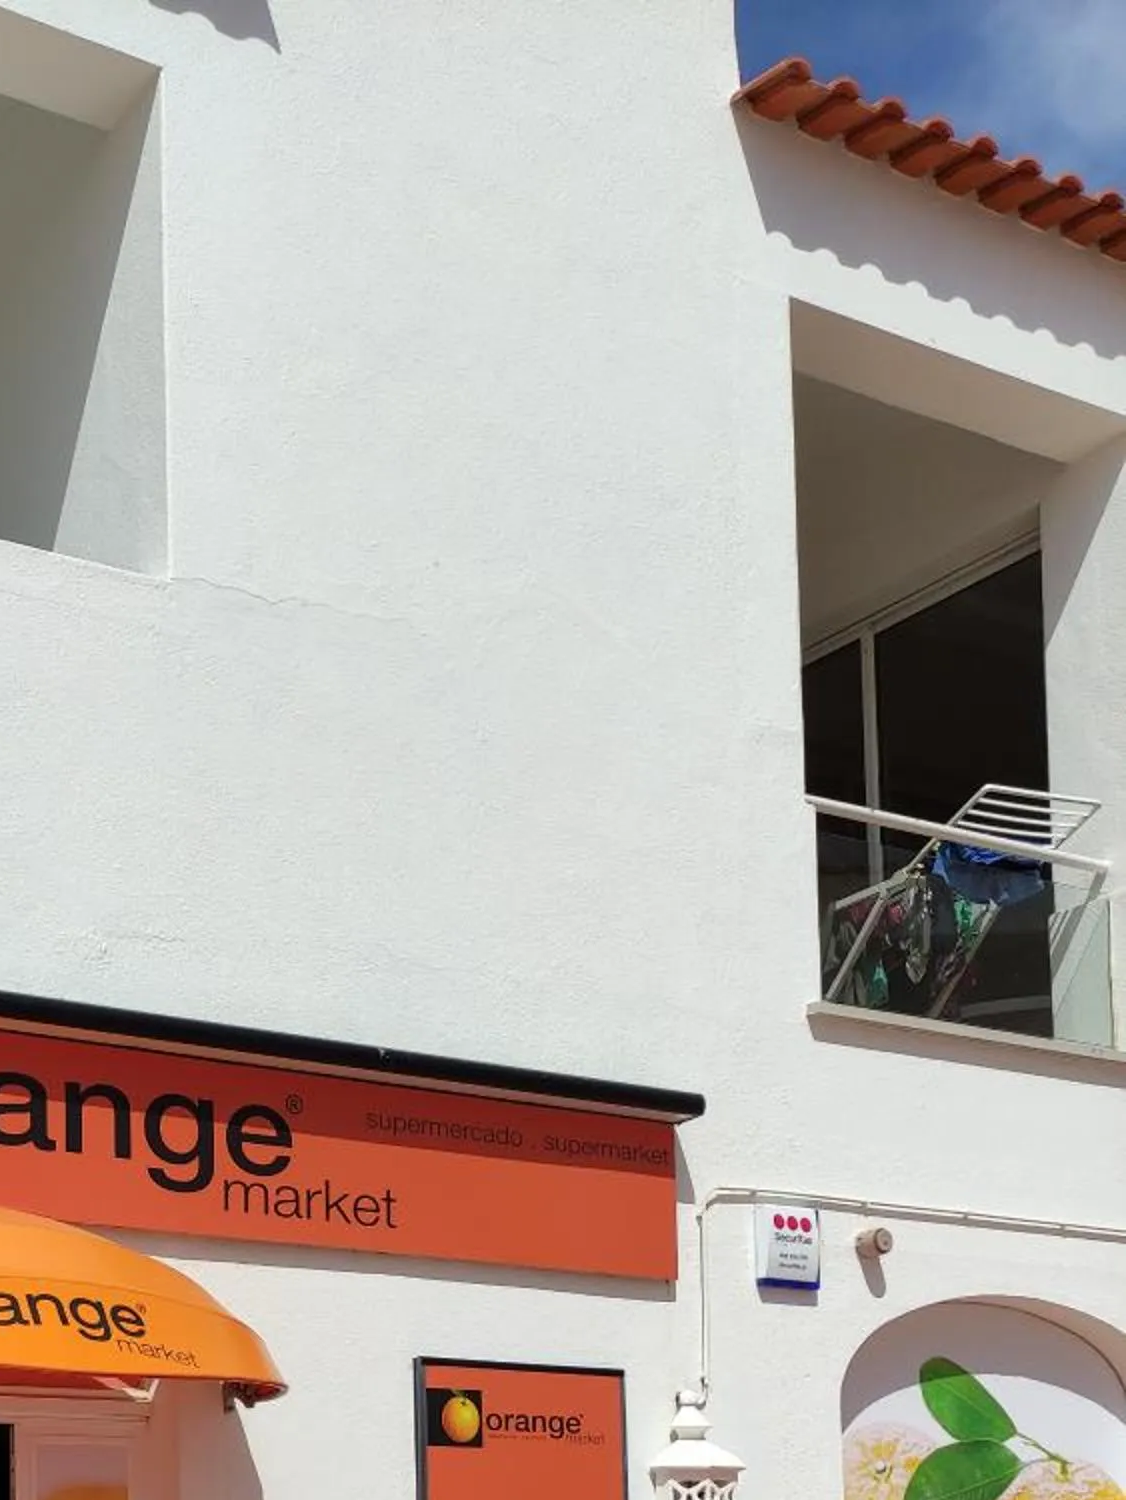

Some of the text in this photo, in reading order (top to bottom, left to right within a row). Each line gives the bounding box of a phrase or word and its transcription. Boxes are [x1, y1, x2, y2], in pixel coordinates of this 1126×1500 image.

[364, 1110, 524, 1147] supermercado
[543, 1132, 670, 1166] supermarket
[222, 1177, 398, 1229] market
[115, 1338, 201, 1369] market
[485, 1411, 582, 1439] orange
